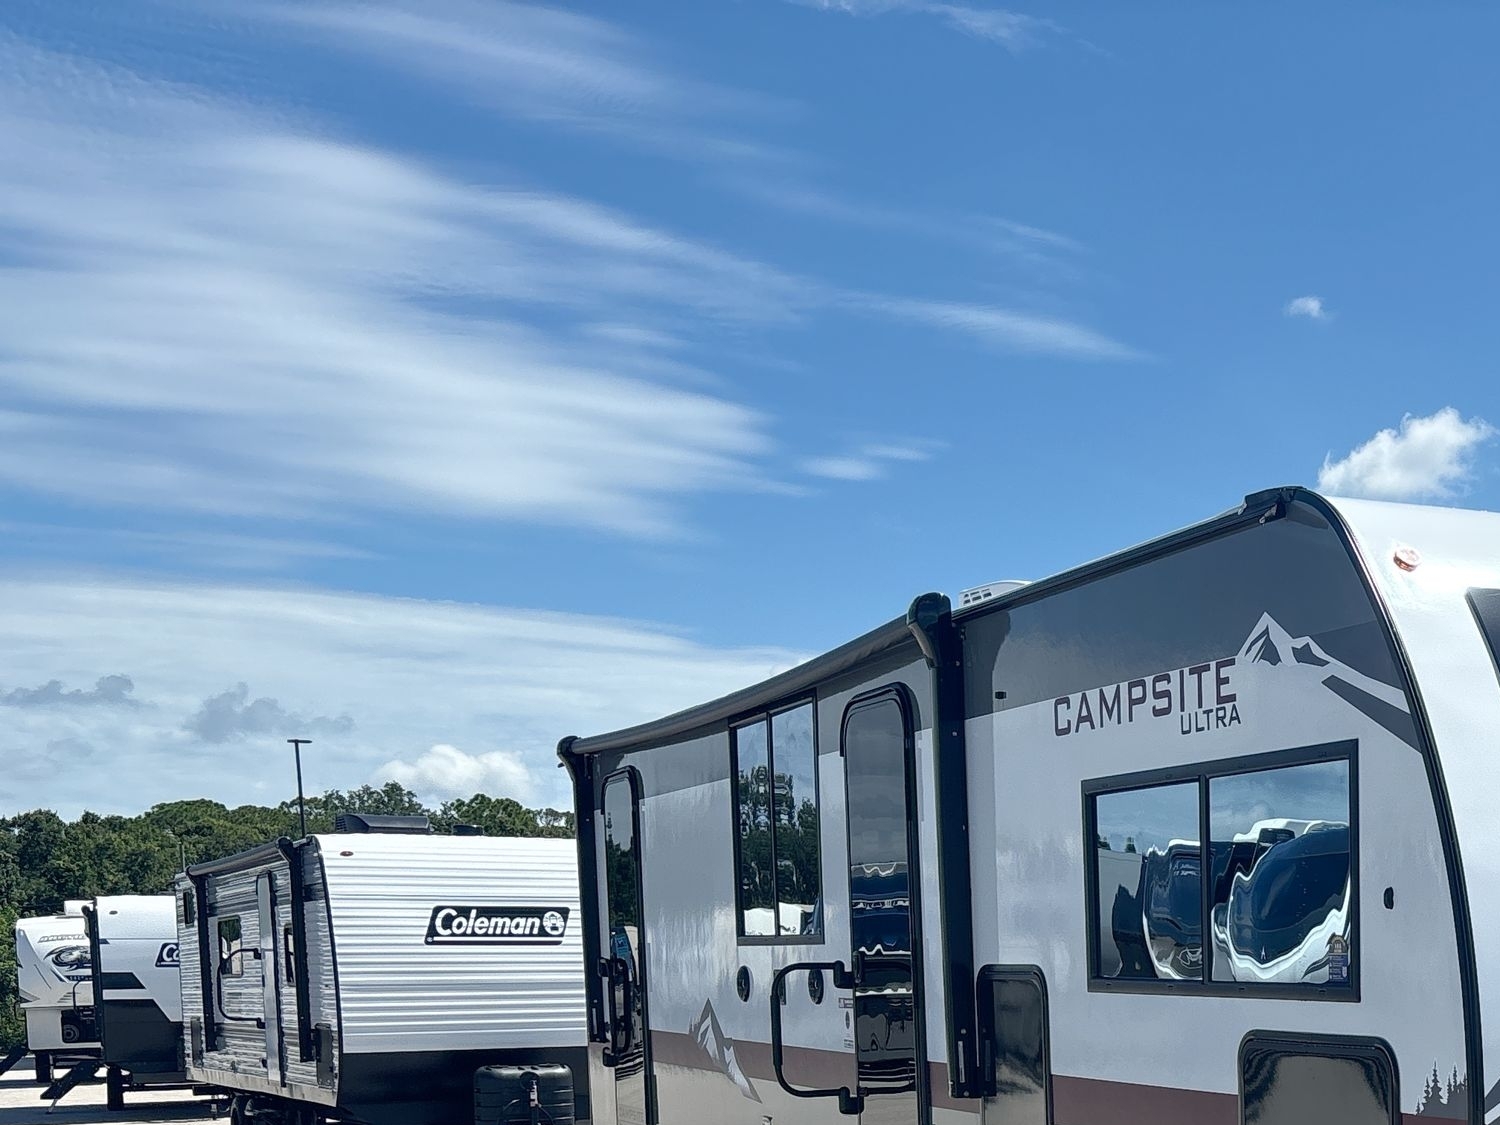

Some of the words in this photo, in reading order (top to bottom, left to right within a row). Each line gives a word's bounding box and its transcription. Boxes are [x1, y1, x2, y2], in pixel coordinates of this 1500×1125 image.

[1054, 659, 1237, 737] CAMPSITE
[1180, 704, 1241, 735] ULTRA
[435, 908, 541, 936] Coleman
